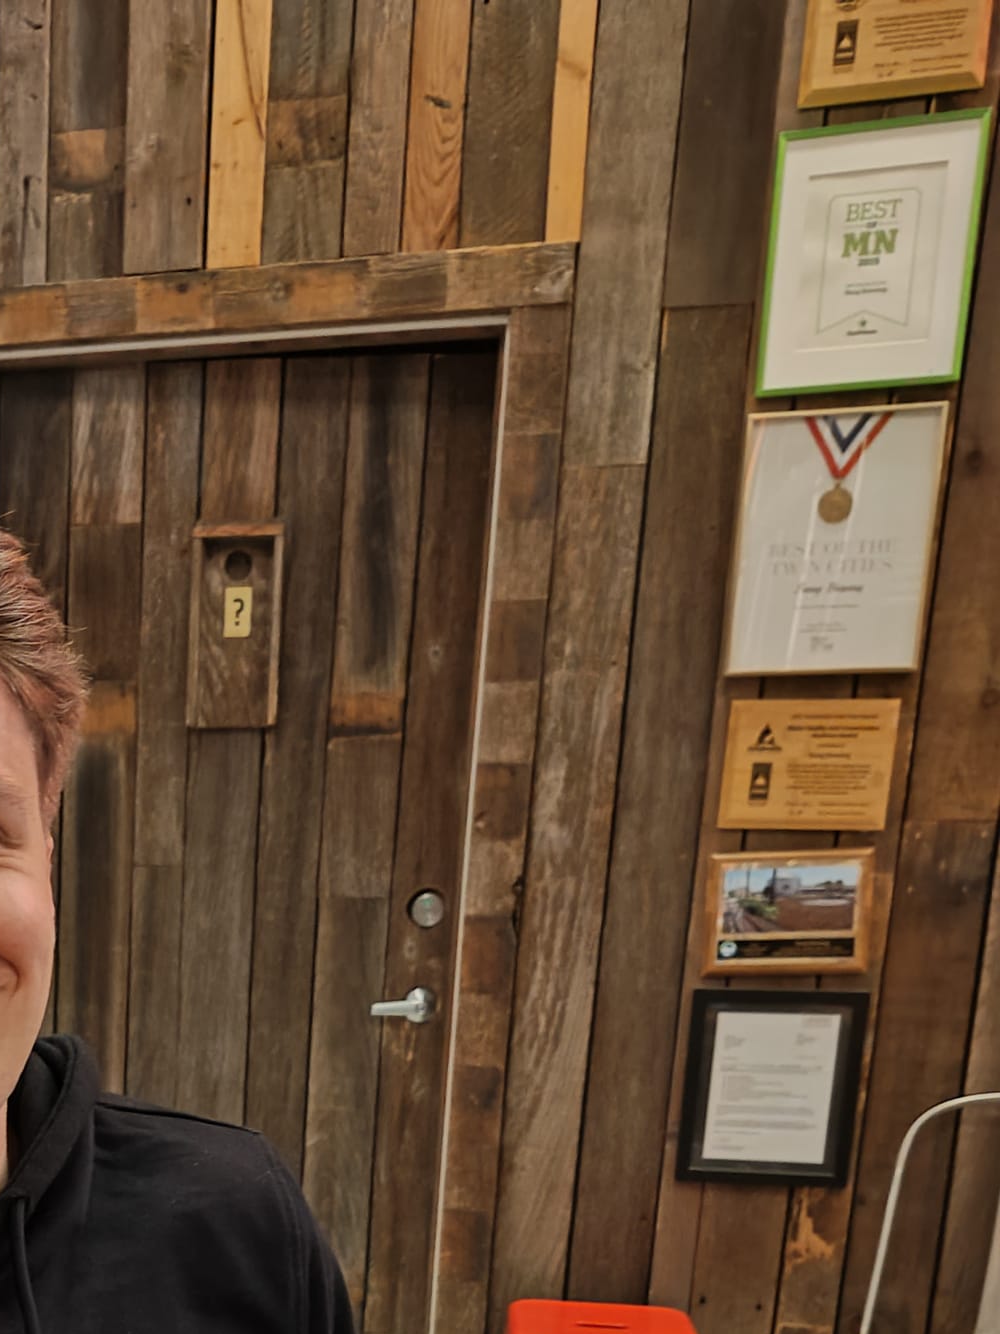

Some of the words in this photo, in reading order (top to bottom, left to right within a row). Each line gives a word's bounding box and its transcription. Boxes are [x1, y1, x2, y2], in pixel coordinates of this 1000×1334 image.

[845, 198, 903, 222] BEST
[841, 228, 899, 258] MN
[770, 560, 821, 576] TWN
[233, 598, 245, 627] ?
